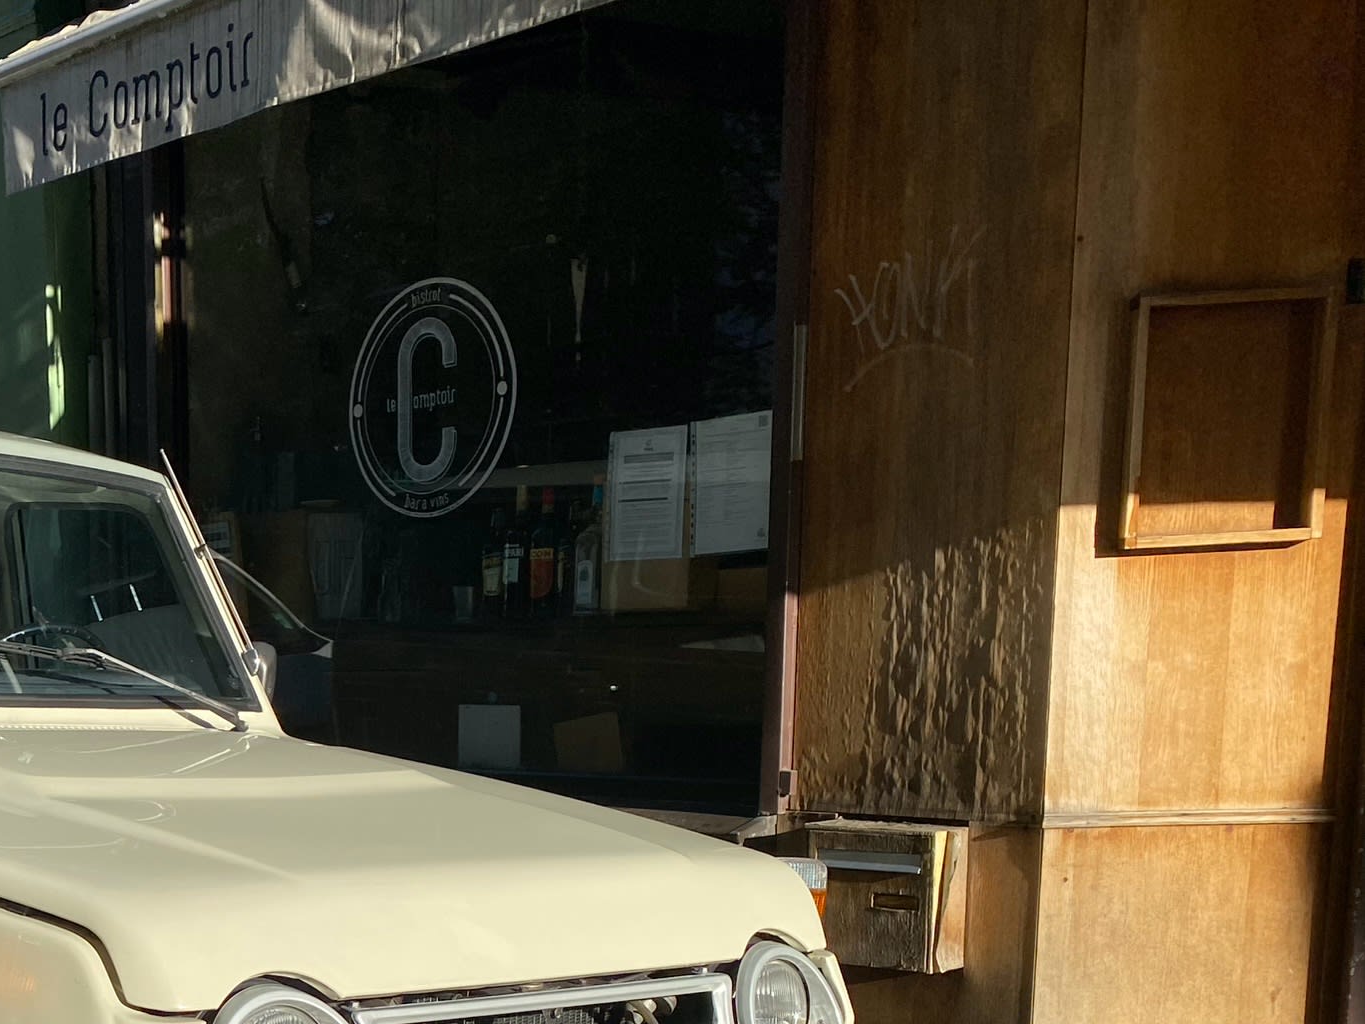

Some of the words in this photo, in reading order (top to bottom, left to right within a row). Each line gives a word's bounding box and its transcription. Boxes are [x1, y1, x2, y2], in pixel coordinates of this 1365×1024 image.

[40, 93, 69, 157] le
[87, 23, 255, 139] Comptoir
[410, 288, 442, 308] bistrot
